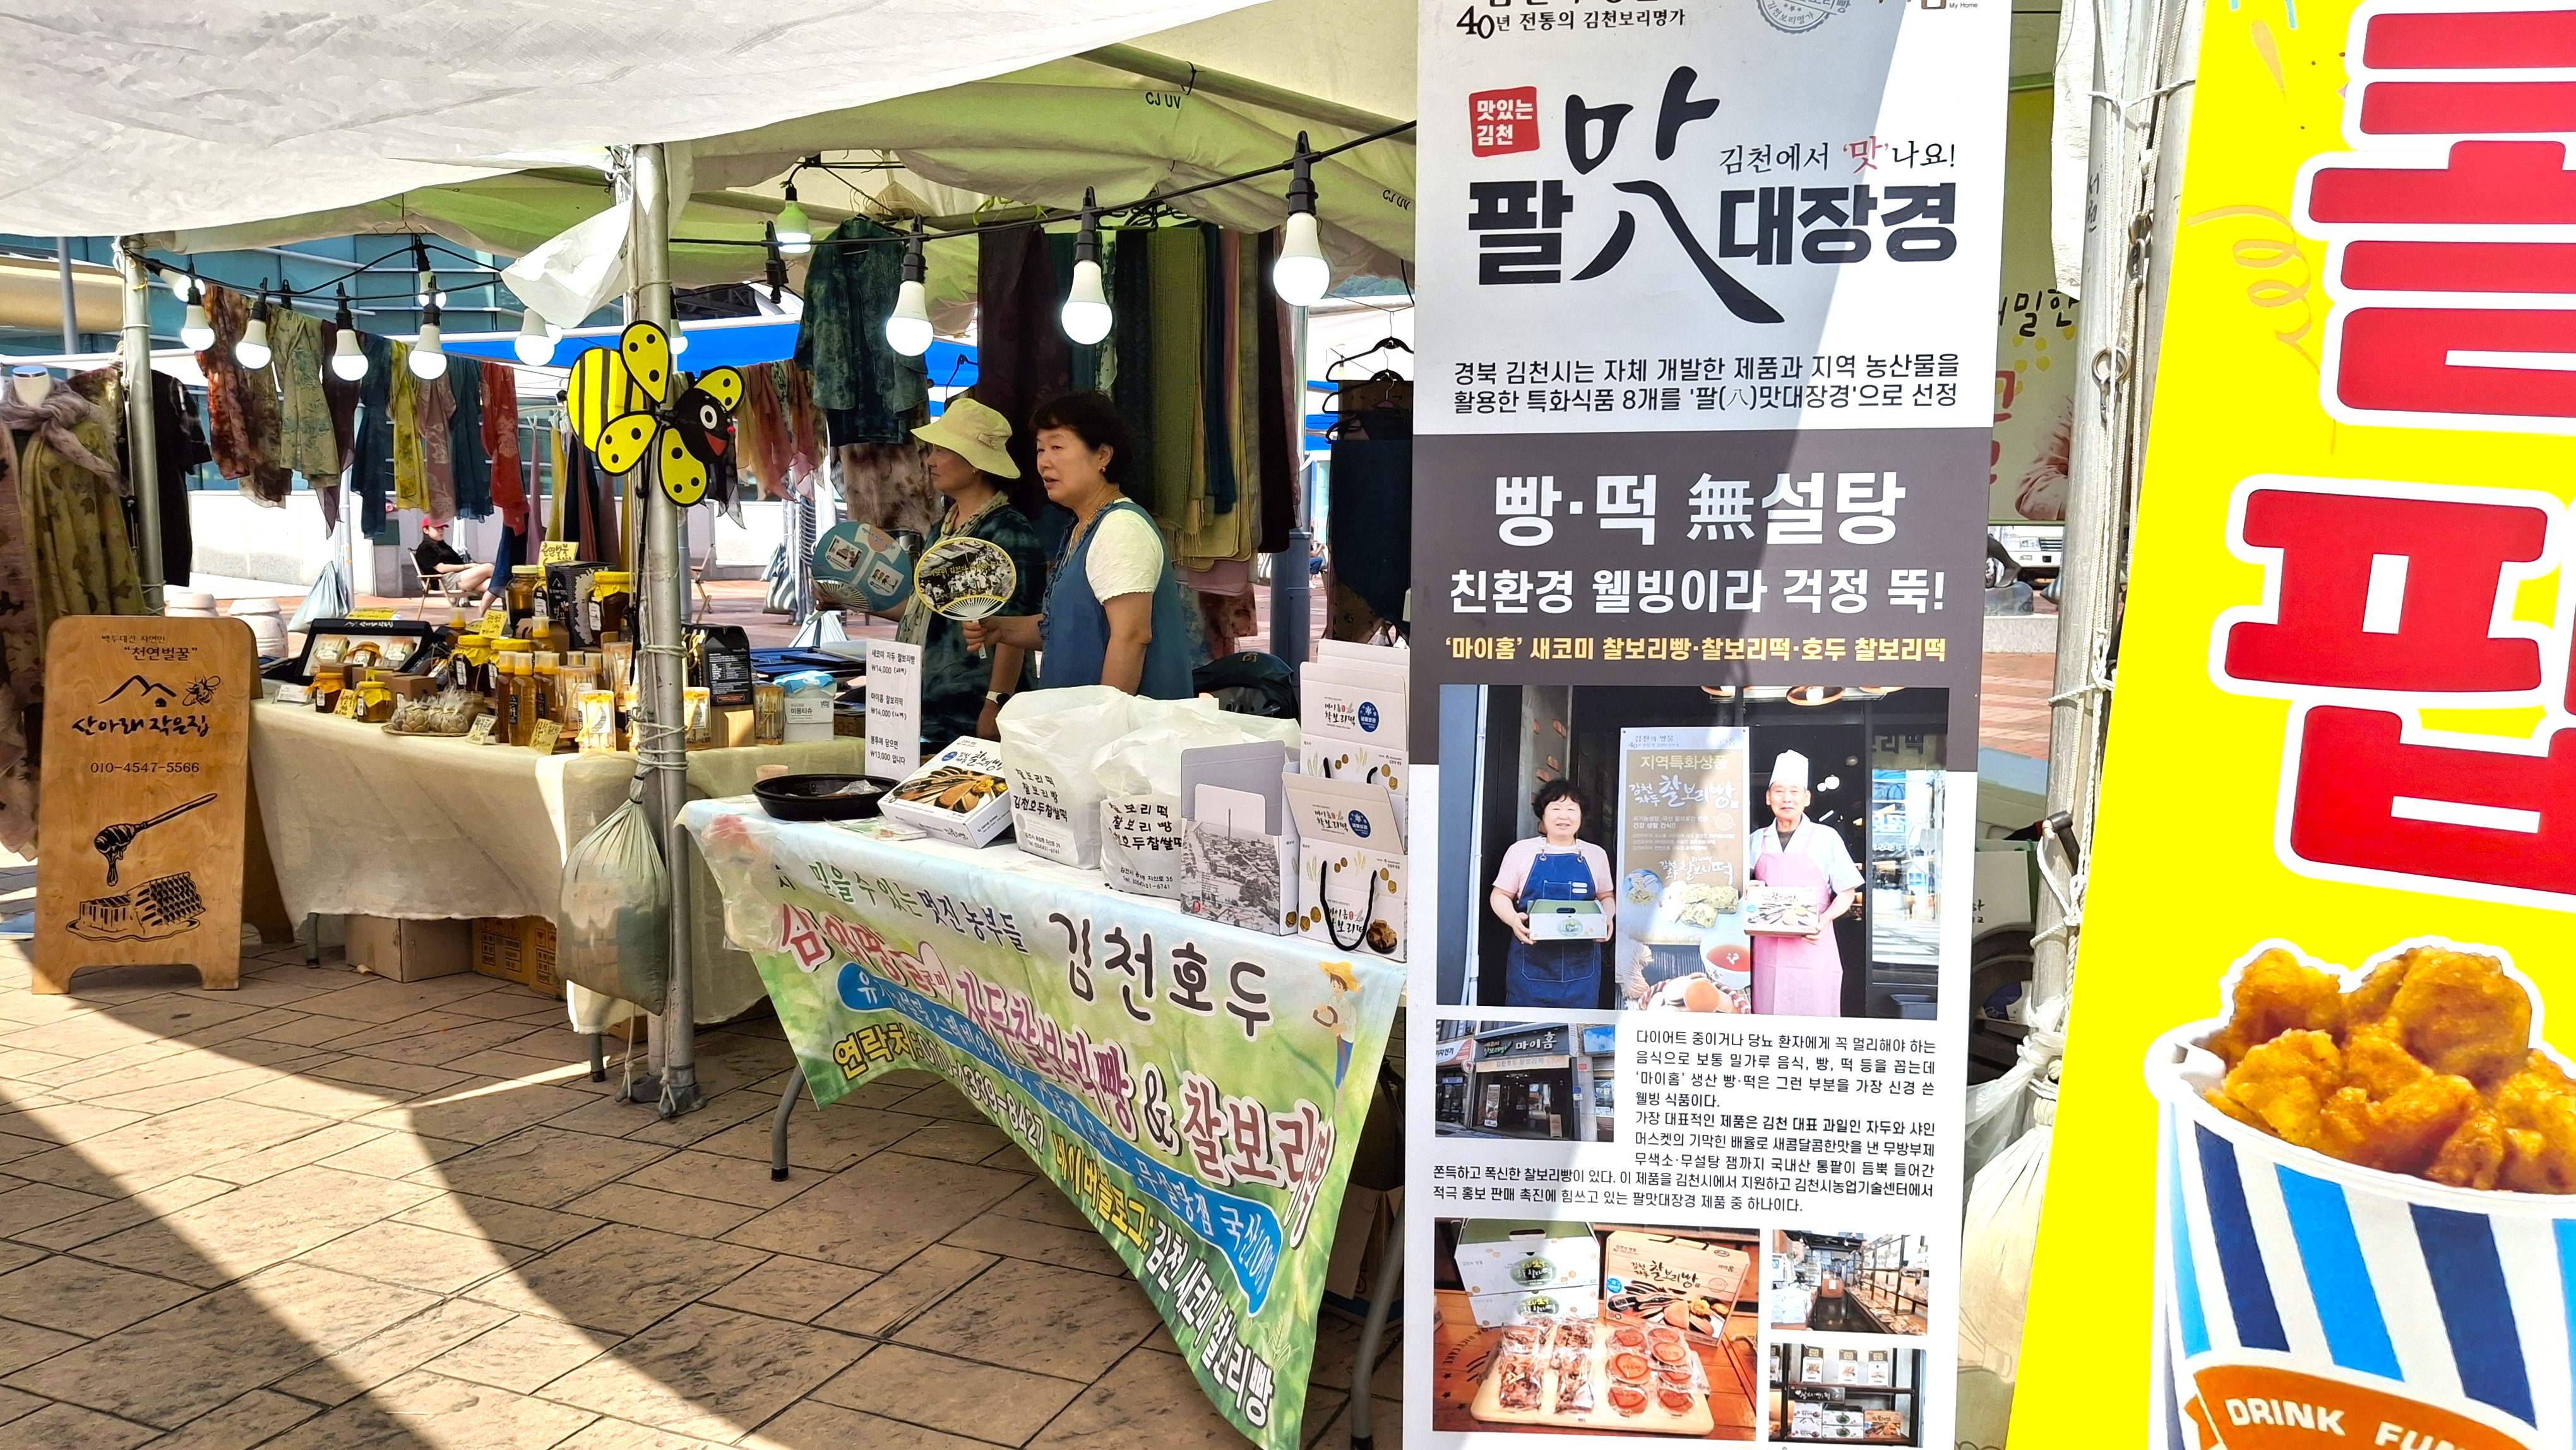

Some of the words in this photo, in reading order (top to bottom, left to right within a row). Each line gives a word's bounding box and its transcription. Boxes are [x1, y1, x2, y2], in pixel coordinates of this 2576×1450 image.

[1456, 5, 1510, 39] 40년
[1519, 11, 1575, 31] 전통의
[1583, 9, 1686, 29] 김천보리명가
[1145, 92, 1162, 106] CJ
[1165, 94, 1181, 109] UV
[1477, 99, 1534, 121] 맛있는
[1477, 124, 1513, 146] 김천
[1719, 143, 1830, 174] 김천에서
[1382, 189, 1396, 203] CJ
[1455, 361, 1496, 385] 경북
[1506, 358, 1594, 385] 김천시는
[1603, 358, 1647, 382] 자체
[1658, 356, 1726, 381] 개발한
[1734, 355, 1803, 381] 제품과
[1811, 354, 1857, 379] 지역
[1865, 352, 1959, 378] 농산물을
[1454, 390, 1519, 413] 활용한
[1527, 388, 1614, 412] 특화식품
[1622, 386, 1681, 411] 8개를
[1912, 382, 1957, 408] 선정
[1686, 472, 1906, 545] 無설탕
[1450, 569, 1573, 614] 친환경
[1594, 568, 1768, 614] 웰빙이라
[1783, 568, 1868, 614] 걱정
[1887, 569, 1944, 613] 뚝!
[140, 635, 165, 644] 자연인
[1530, 637, 1594, 661] 새코미
[1855, 637, 1946, 662] 찰보리떡
[886, 651, 895, 662] 자두
[790, 707, 813, 715] 미용티슈
[71, 715, 144, 738] 산아래
[90, 762, 200, 773] 010-4547-5566
[892, 755, 906, 765] 입니다
[1640, 755, 1729, 770] 지역특화상품
[1628, 782, 1652, 796] 김천
[1635, 795, 1661, 807] 자두
[808, 861, 854, 904] 믿을
[857, 872, 877, 906] 수
[880, 877, 924, 918] 있는
[917, 890, 964, 934] 멋진
[961, 902, 1029, 955] 농부들
[1049, 913, 1272, 1037] 김천호두
[1515, 1031, 1558, 1050] 마이홈
[1637, 1030, 1687, 1045] 다이어트
[1692, 1031, 1743, 1047] 중이거나
[1748, 1033, 1773, 1048] 당뇨
[1779, 1034, 1830, 1050] 환자에게
[1835, 1036, 1847, 1051] 꼭
[1853, 1037, 1906, 1053] 멀리해야
[1910, 1038, 1936, 1054] 하는
[1637, 1050, 1690, 1065] 음식으로
[1696, 1053, 1723, 1067] 보통
[1730, 1053, 1770, 1069] 밀가루
[1777, 1055, 1809, 1071] 음식,
[1816, 1057, 1834, 1072] 빵,
[1841, 1057, 1853, 1072] 떡
[1860, 1058, 1887, 1073] 등을
[1894, 1059, 1935, 1075] 꼽는데
[1691, 1073, 1718, 1088] 생산
[1776, 1076, 1802, 1091] 그런
[1808, 1077, 1849, 1093] 부분을
[1856, 1079, 1883, 1094] 가장
[1888, 1080, 1916, 1095] 신경
[1922, 1081, 1935, 1096] 쓴
[1144, 1069, 1174, 1144] &
[1636, 1091, 1661, 1106] 웰빙
[1665, 1093, 1720, 1108] 식품이다.
[1635, 1111, 1660, 1125] 가장
[1665, 1113, 1715, 1128] 대표적인
[1720, 1114, 1758, 1129] 제품은
[1763, 1116, 1787, 1130] 김천
[1793, 1117, 1818, 1132] 대표
[1823, 1118, 1861, 1134] 과일인
[1866, 1120, 1905, 1135] 자두와
[1910, 1121, 1935, 1137] 샤인
[1635, 1132, 1685, 1147] 머스켓의
[1690, 1134, 1726, 1149] 기막힌
[1731, 1135, 1768, 1151] 배율로
[1772, 1137, 1862, 1154] 새콤달콤한맛을
[1866, 1140, 1879, 1154] 낸
[1883, 1141, 1935, 1157] 무방부제
[1726, 1156, 1765, 1171] 잼까지
[1770, 1158, 1810, 1173] 국내산
[1816, 1160, 1856, 1175] 통팥이
[1862, 1162, 1888, 1177] 듬뿍
[1895, 1163, 1935, 1178] 들어간
[1433, 1165, 1481, 1180] 쫀득하고
[1485, 1166, 1521, 1182] 폭신한
[1524, 1168, 1585, 1183] 찰보리빵이
[1589, 1170, 1616, 1184] 있다.
[1620, 1171, 1631, 1185] 이
[1636, 1171, 1673, 1186] 제품을
[1676, 1173, 1737, 1189] 김천시에서
[1741, 1175, 1791, 1191] 지원하고
[1795, 1177, 1933, 1197] 김천시농업기술센터에서
[1433, 1185, 1457, 1199] 적극
[1462, 1186, 1486, 1201] 홍보
[1491, 1187, 1515, 1201] 판매
[1519, 1188, 1556, 1202] 촉진에
[1561, 1189, 1599, 1204] 힘쓰고
[1604, 1190, 1628, 1205] 있는
[1633, 1192, 1696, 1207] 팔맛대장경
[1701, 1194, 1726, 1209] 제품
[1731, 1196, 1743, 1210] 중
[1748, 1197, 1803, 1212] 하나이다.
[1630, 1262, 1646, 1271] 김천
[1649, 1260, 1698, 1288] 찰보리빵
[1634, 1270, 1649, 1279] 자두
[2224, 1397, 2346, 1436] DRINK
